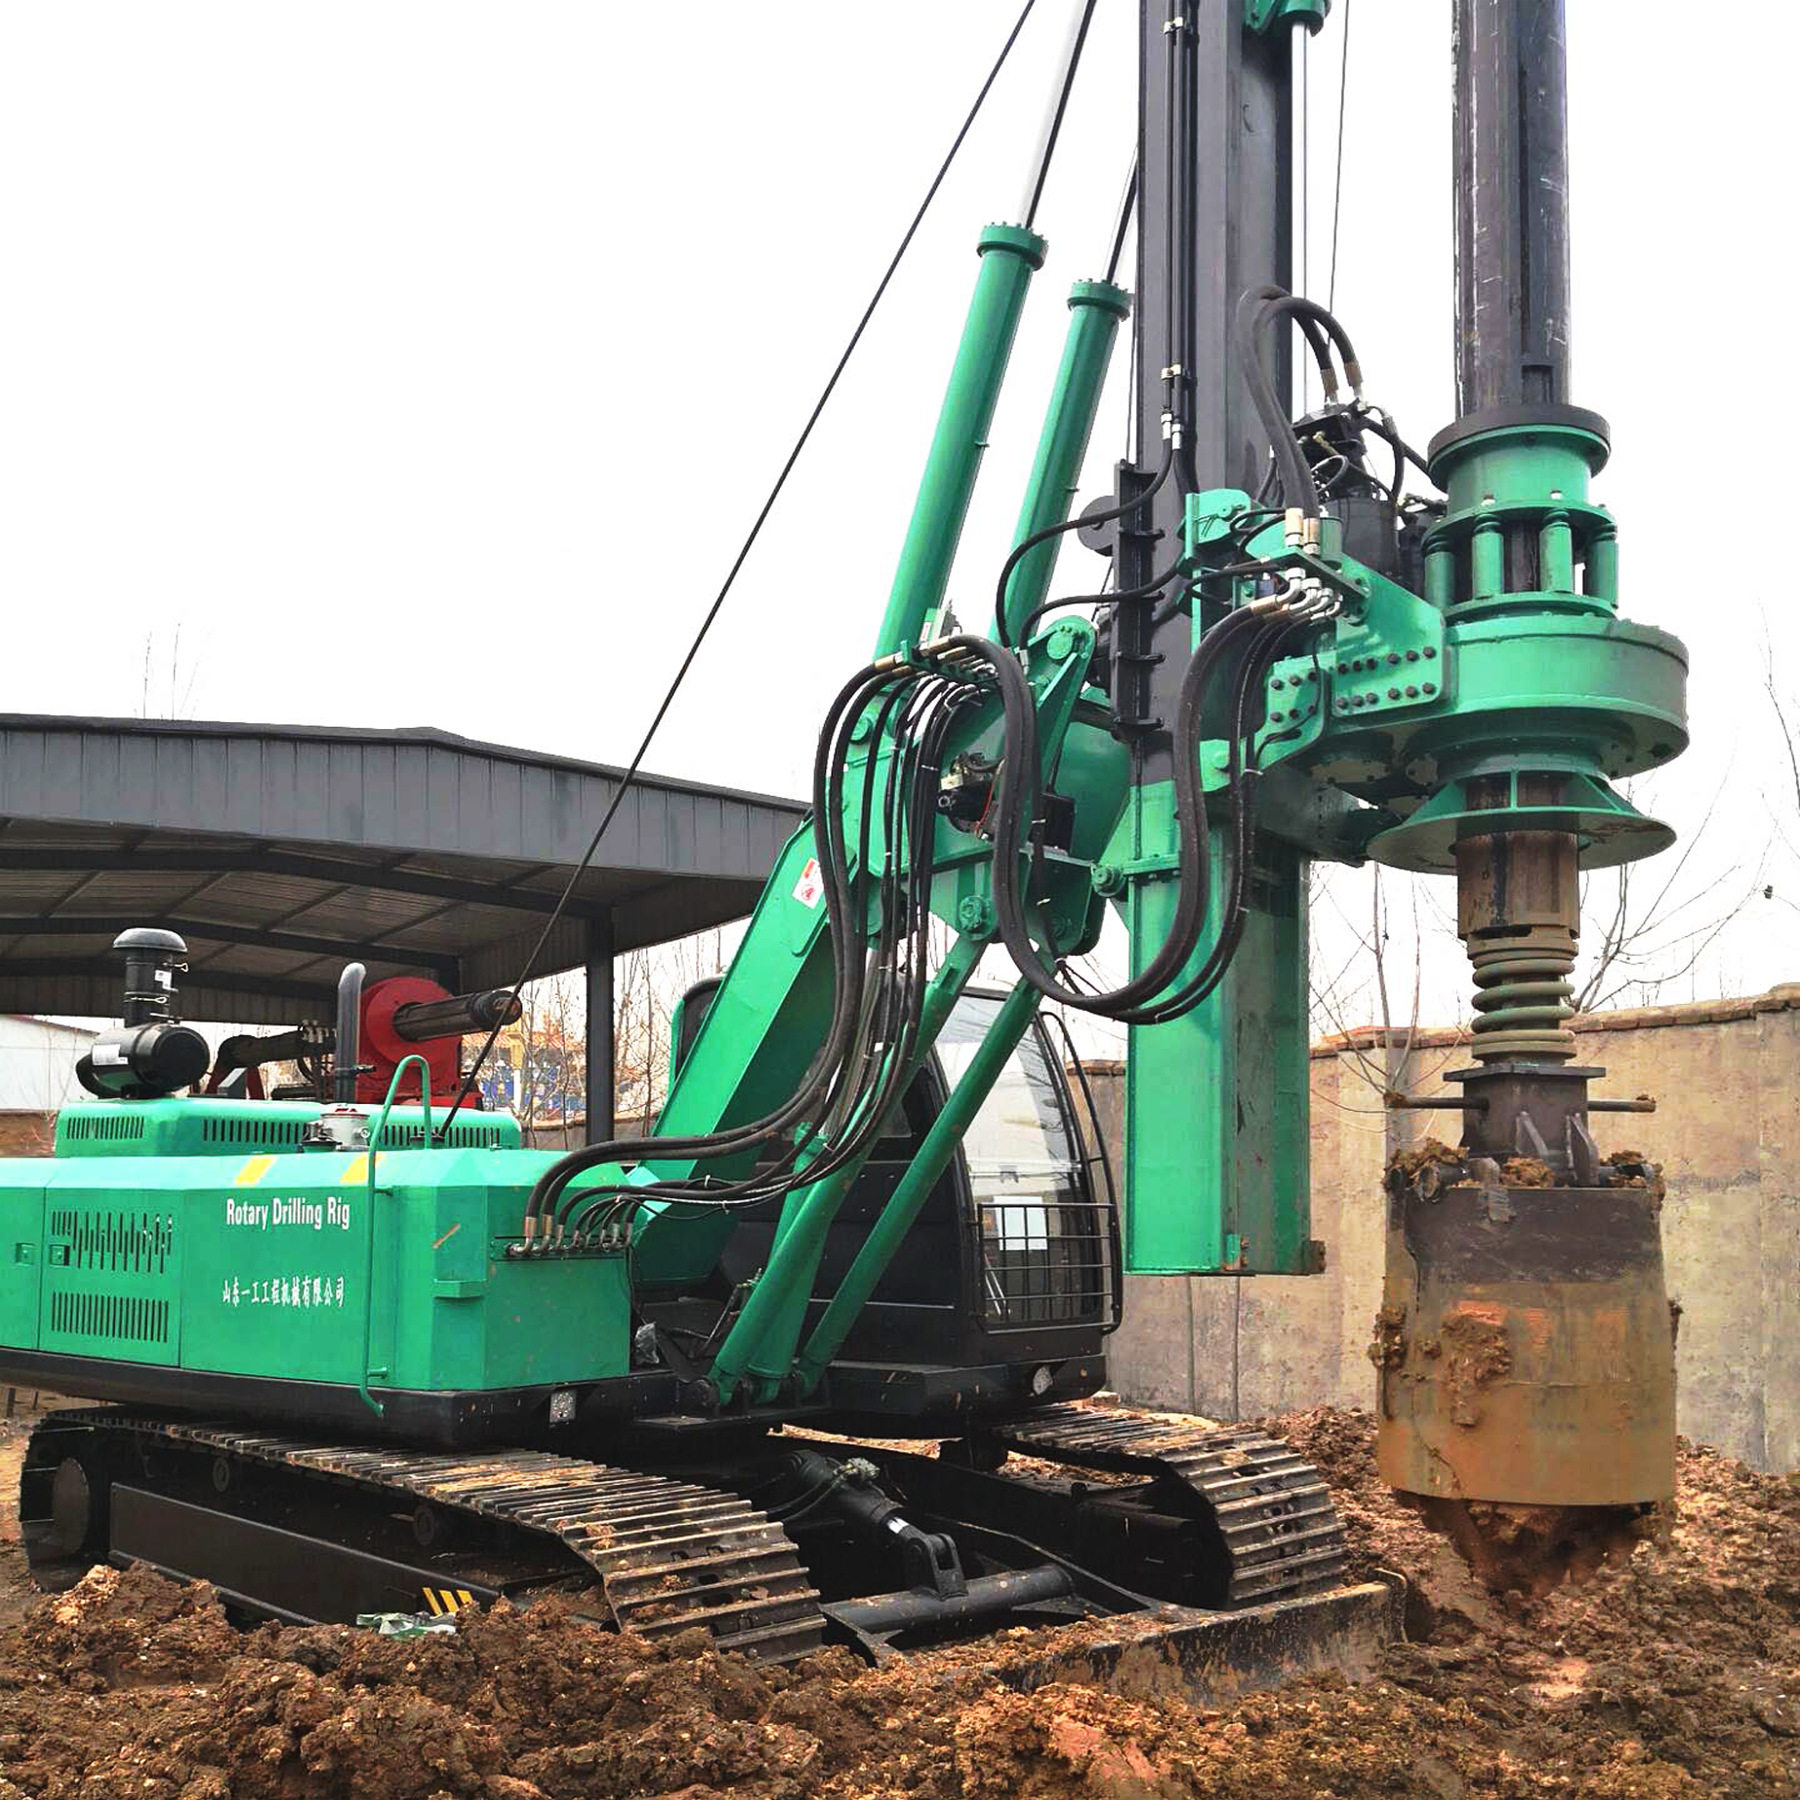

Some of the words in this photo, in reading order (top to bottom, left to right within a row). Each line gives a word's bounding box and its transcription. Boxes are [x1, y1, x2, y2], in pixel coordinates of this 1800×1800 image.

[226, 1198, 269, 1231] Rotary
[272, 1197, 323, 1231] Drilling
[327, 1196, 350, 1231] Rig
